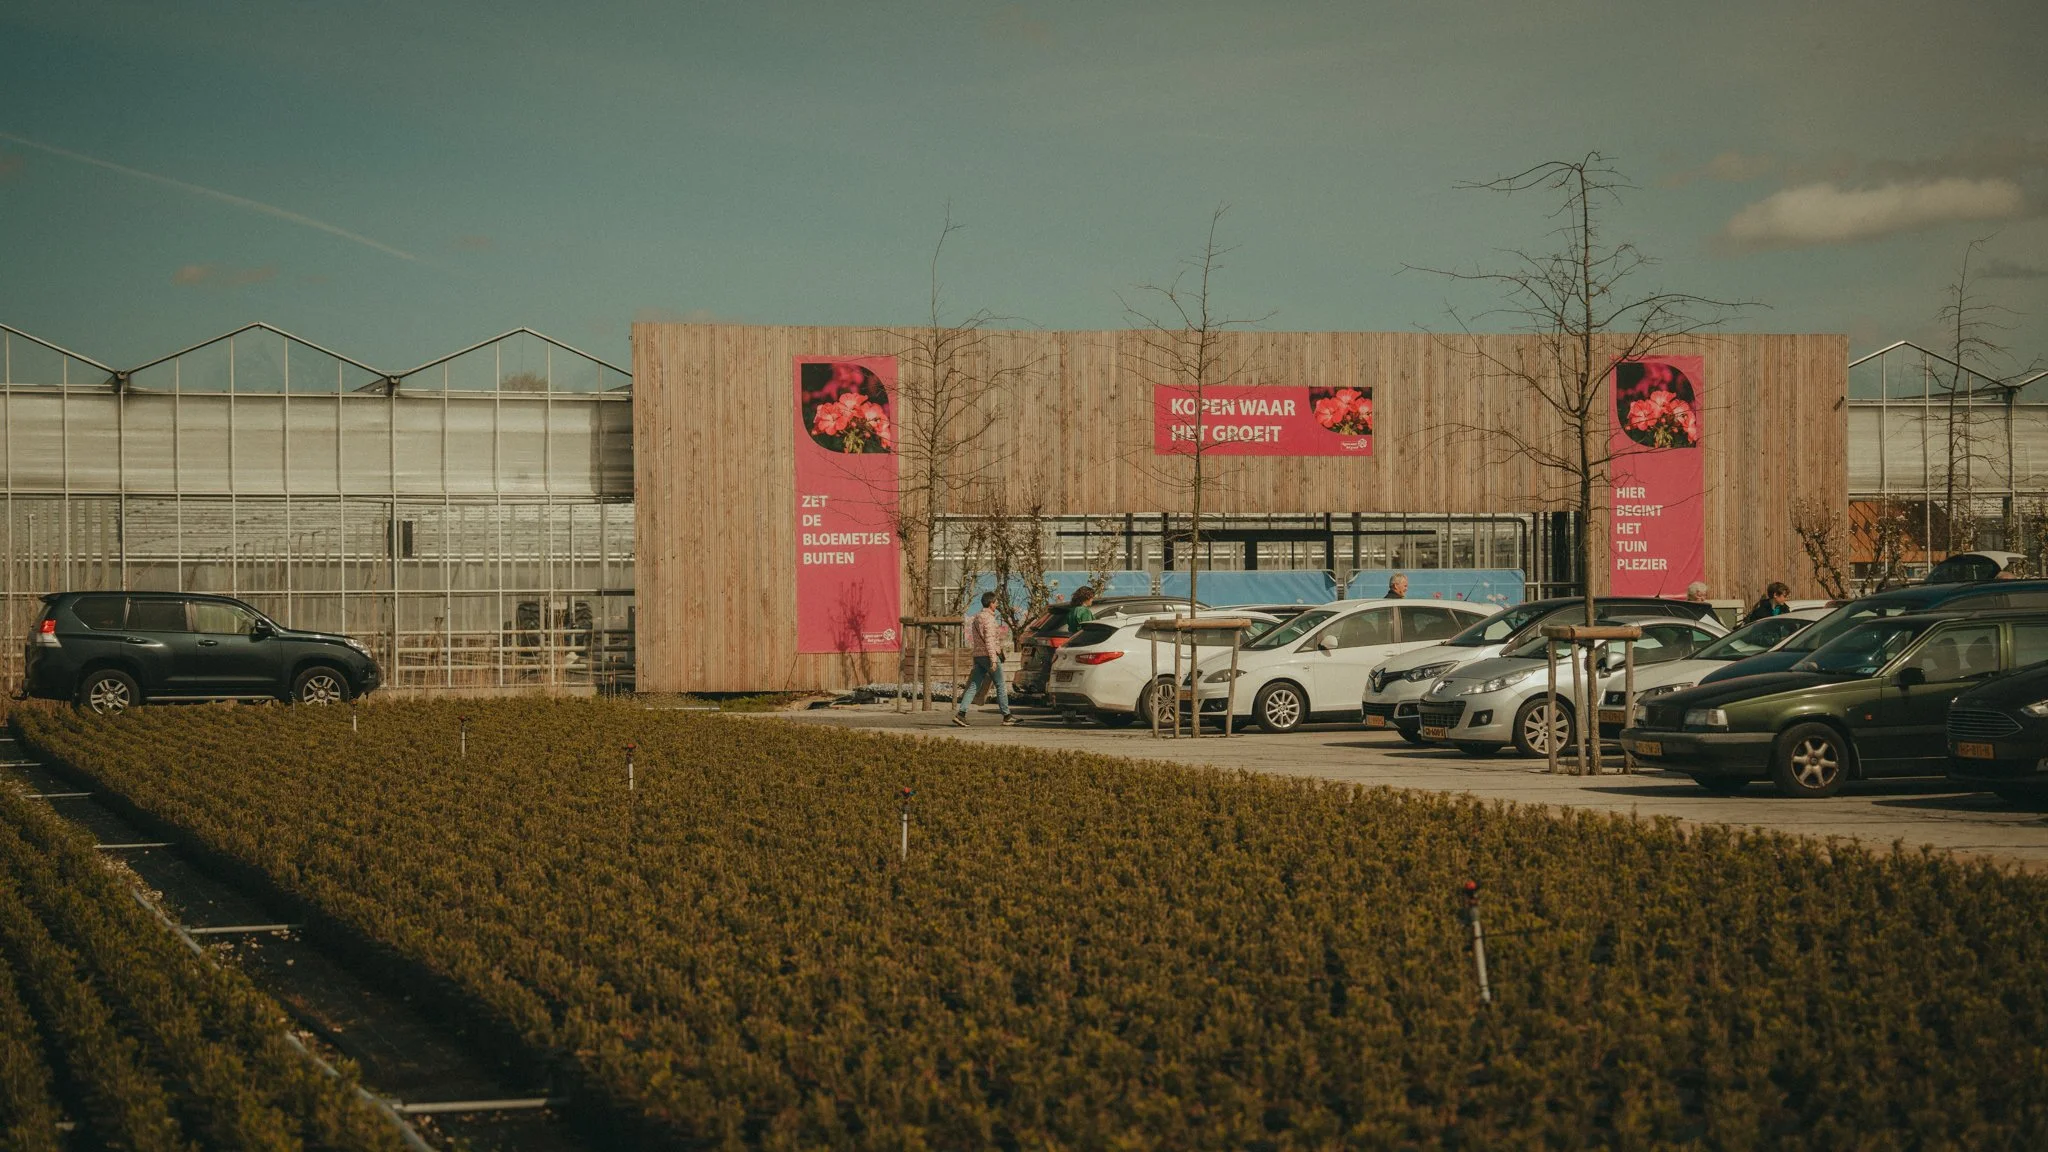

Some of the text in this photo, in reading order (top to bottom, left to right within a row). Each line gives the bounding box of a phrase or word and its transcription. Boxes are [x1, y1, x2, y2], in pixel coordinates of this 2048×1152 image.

[1171, 398, 1296, 416] KOPEN WAAR
[1171, 425, 1282, 442] HET GROEIT
[1616, 487, 1646, 499] HIER
[802, 495, 828, 508] ZET
[1616, 505, 1663, 517] BEGINT
[802, 514, 822, 527] DE
[1616, 523, 1641, 535] HET
[803, 532, 890, 546] BLOEMETJES
[1616, 540, 1648, 553] TUIN
[803, 552, 855, 565] BUITEN
[1617, 558, 1668, 571] PLEZIER
